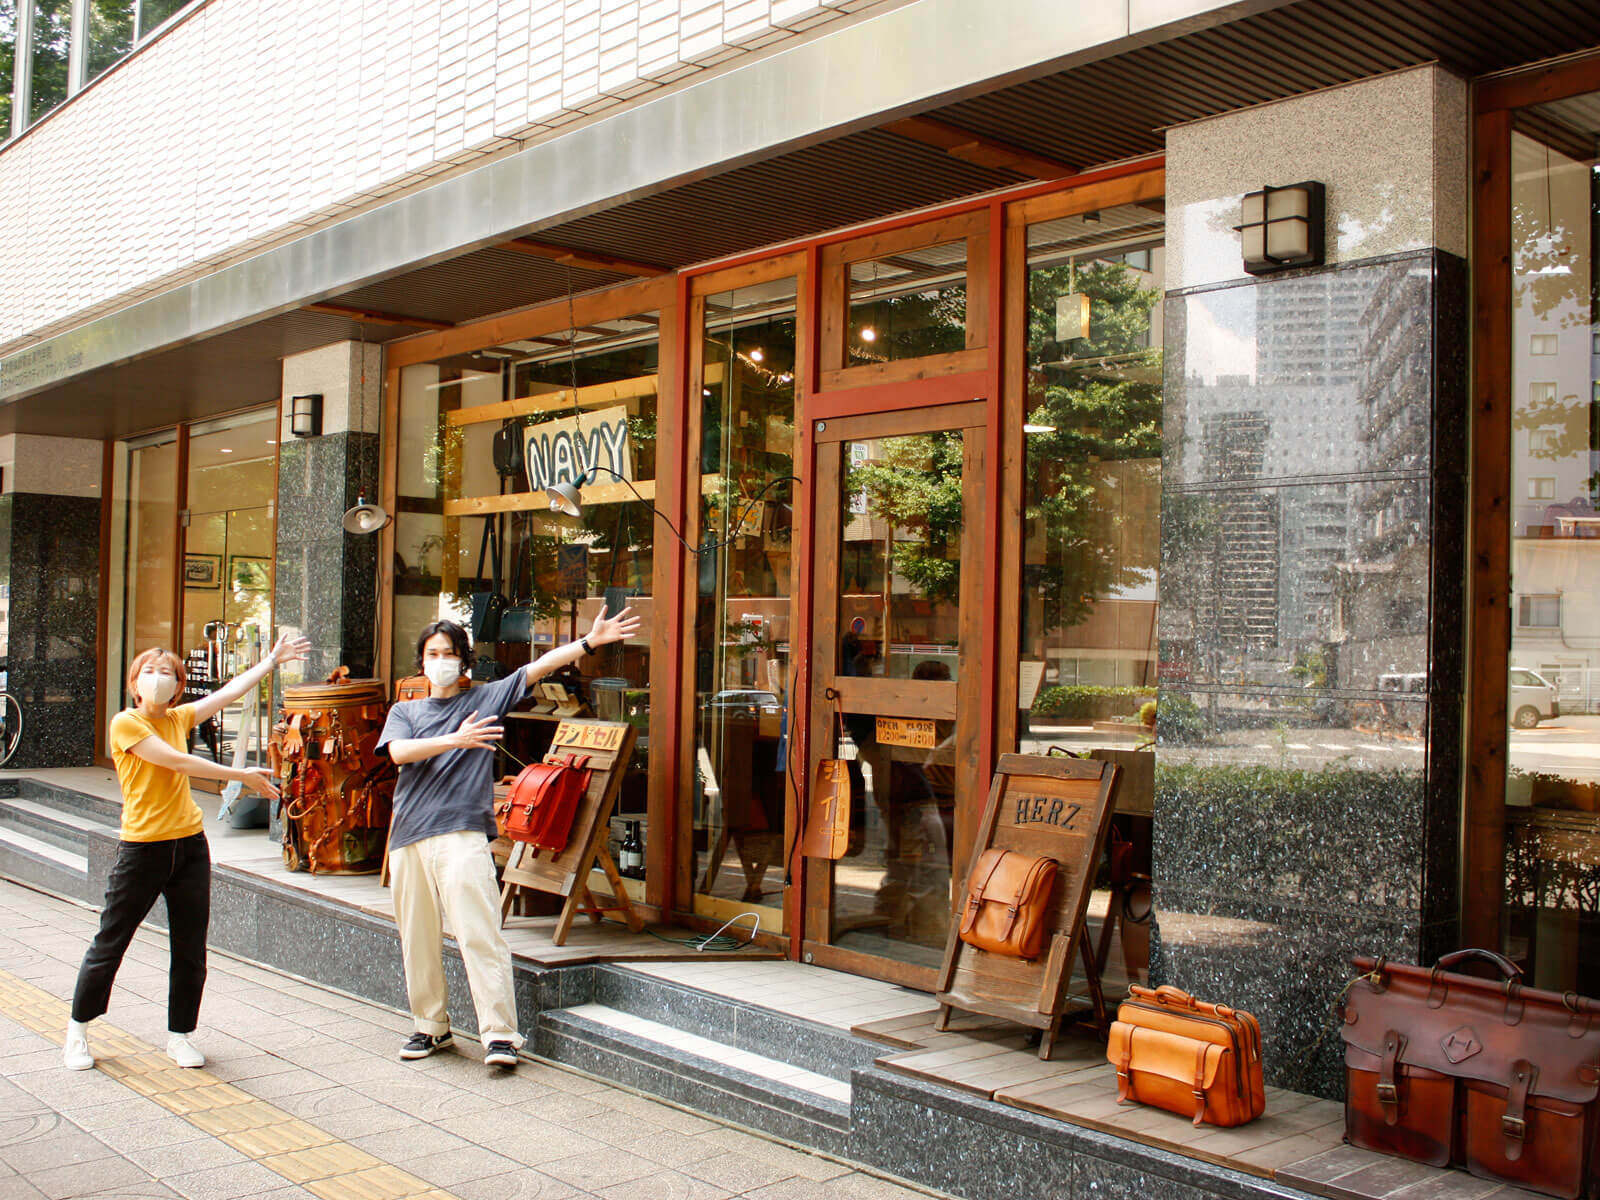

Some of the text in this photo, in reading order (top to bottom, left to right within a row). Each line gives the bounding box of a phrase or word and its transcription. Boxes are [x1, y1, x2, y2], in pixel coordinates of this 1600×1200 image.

[527, 419, 628, 492] NAVY
[556, 724, 619, 747] ランドセル
[1014, 797, 1081, 830] HERZ
